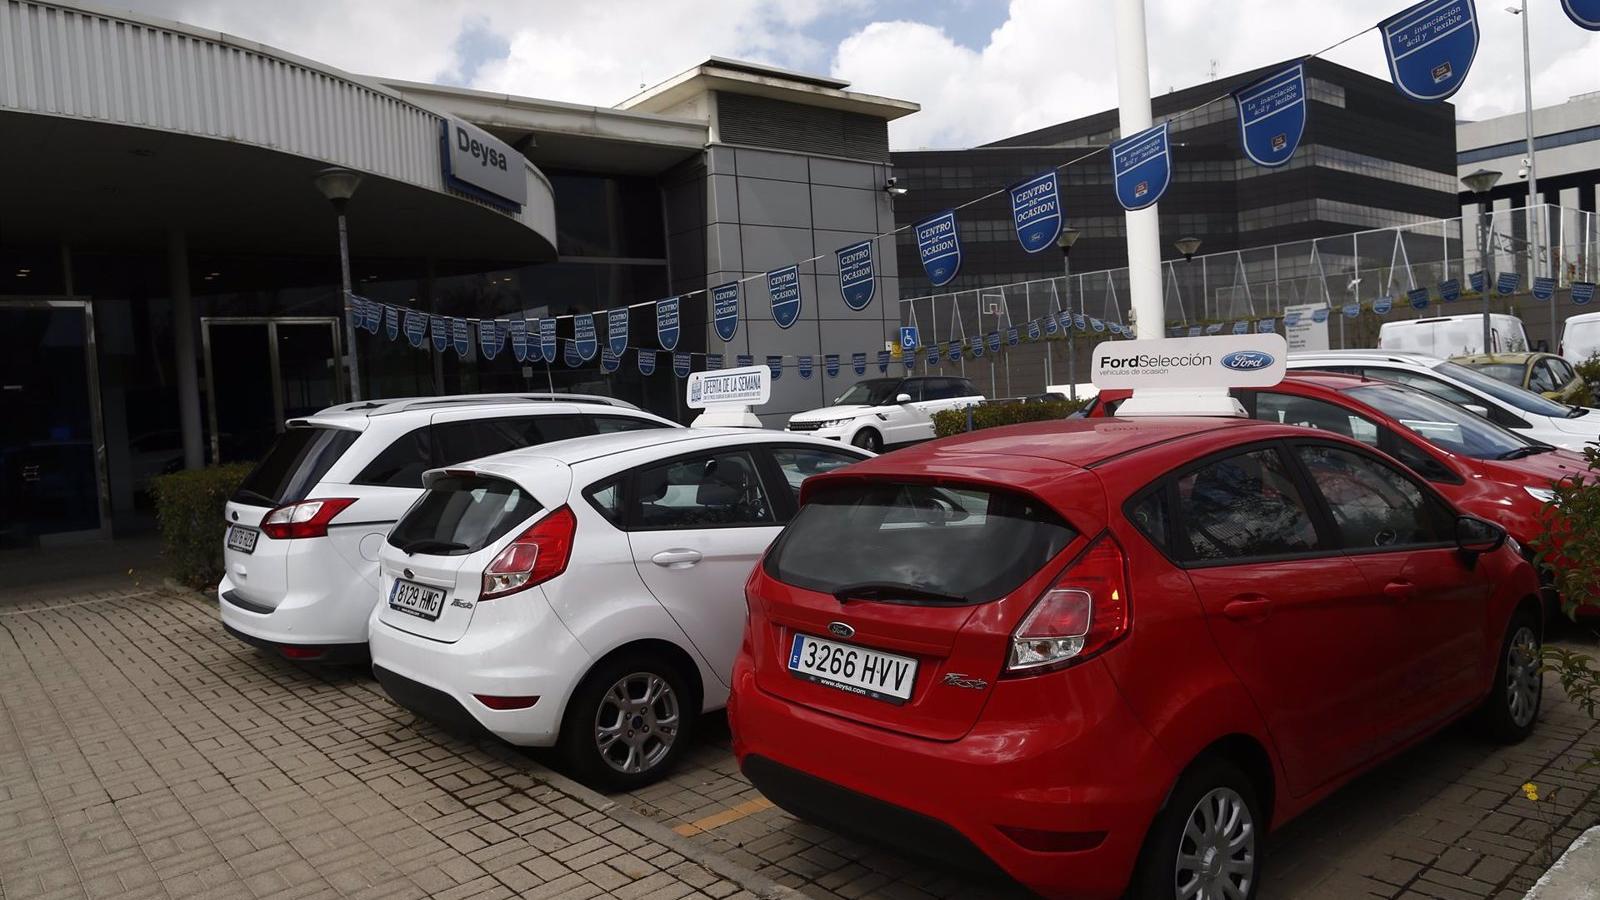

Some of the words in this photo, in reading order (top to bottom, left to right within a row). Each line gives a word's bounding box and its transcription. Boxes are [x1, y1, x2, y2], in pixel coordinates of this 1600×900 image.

[1398, 34, 1408, 43] La
[456, 126, 508, 172] Deysa
[1016, 181, 1053, 203] CENTRO
[1029, 198, 1038, 206] DE
[1017, 201, 1055, 222] OCASION
[920, 221, 951, 239] CENTRO
[922, 240, 954, 257] OCASION
[841, 249, 869, 265] CENTRO
[771, 272, 795, 286] CENTRO
[842, 266, 870, 282] OCASION
[715, 290, 737, 301] CENTRO
[772, 289, 796, 301] OCASION
[1100, 353, 1212, 368] FordSelección
[1231, 354, 1264, 367] Ford
[703, 379, 722, 394] OFERTA
[723, 377, 730, 392] DE
[731, 377, 737, 392] LA
[738, 374, 761, 391] SEMANA
[397, 584, 419, 606] 8129
[804, 641, 858, 678] 3266
[861, 654, 909, 691] HVV
[820, 680, 866, 695] www.deysa.com
